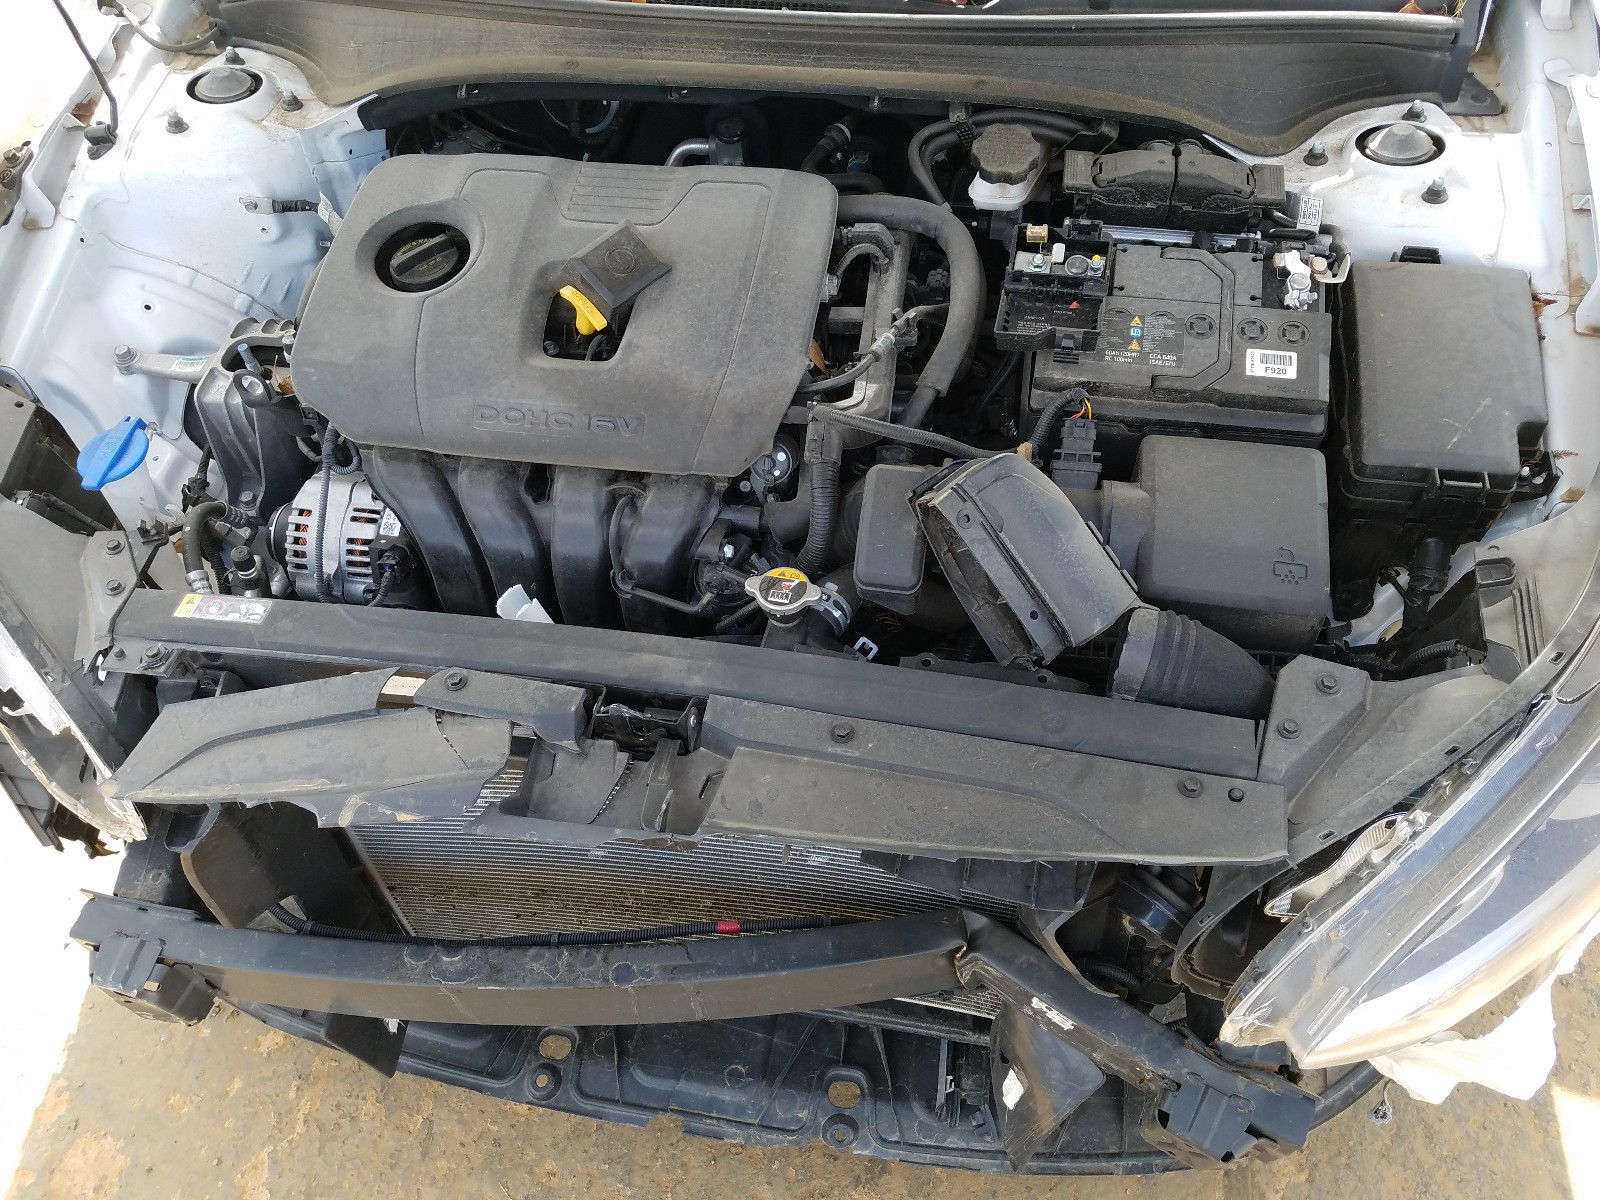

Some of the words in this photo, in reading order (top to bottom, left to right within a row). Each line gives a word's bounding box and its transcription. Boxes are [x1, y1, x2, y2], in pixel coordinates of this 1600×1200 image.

[1264, 366, 1287, 375] F920
[474, 403, 574, 430] DOHC
[587, 413, 646, 437] 16V
